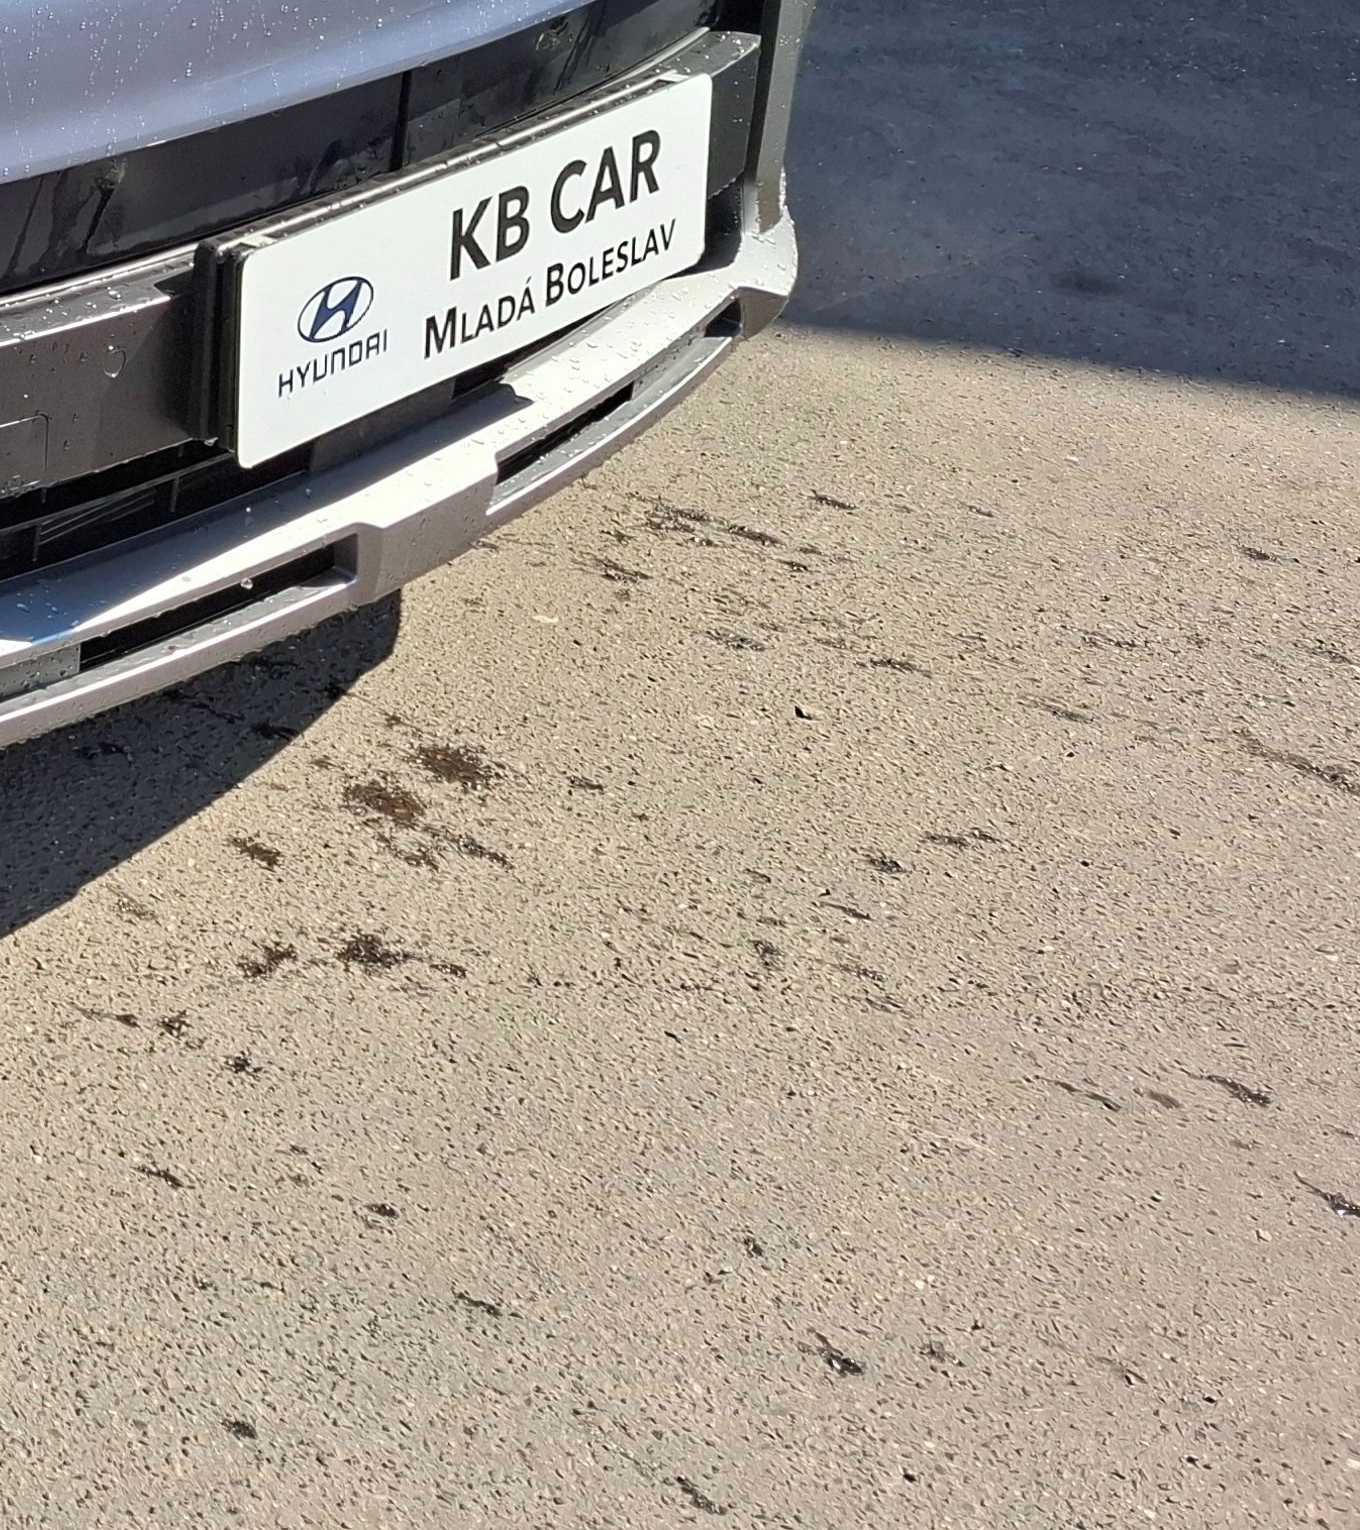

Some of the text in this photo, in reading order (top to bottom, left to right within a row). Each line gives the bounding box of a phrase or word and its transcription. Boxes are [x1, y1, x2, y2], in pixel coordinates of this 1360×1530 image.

[449, 129, 662, 282] KB CAR
[423, 218, 677, 359] MLADÁ BOLESLAV
[277, 328, 388, 398] HYUNDAI
